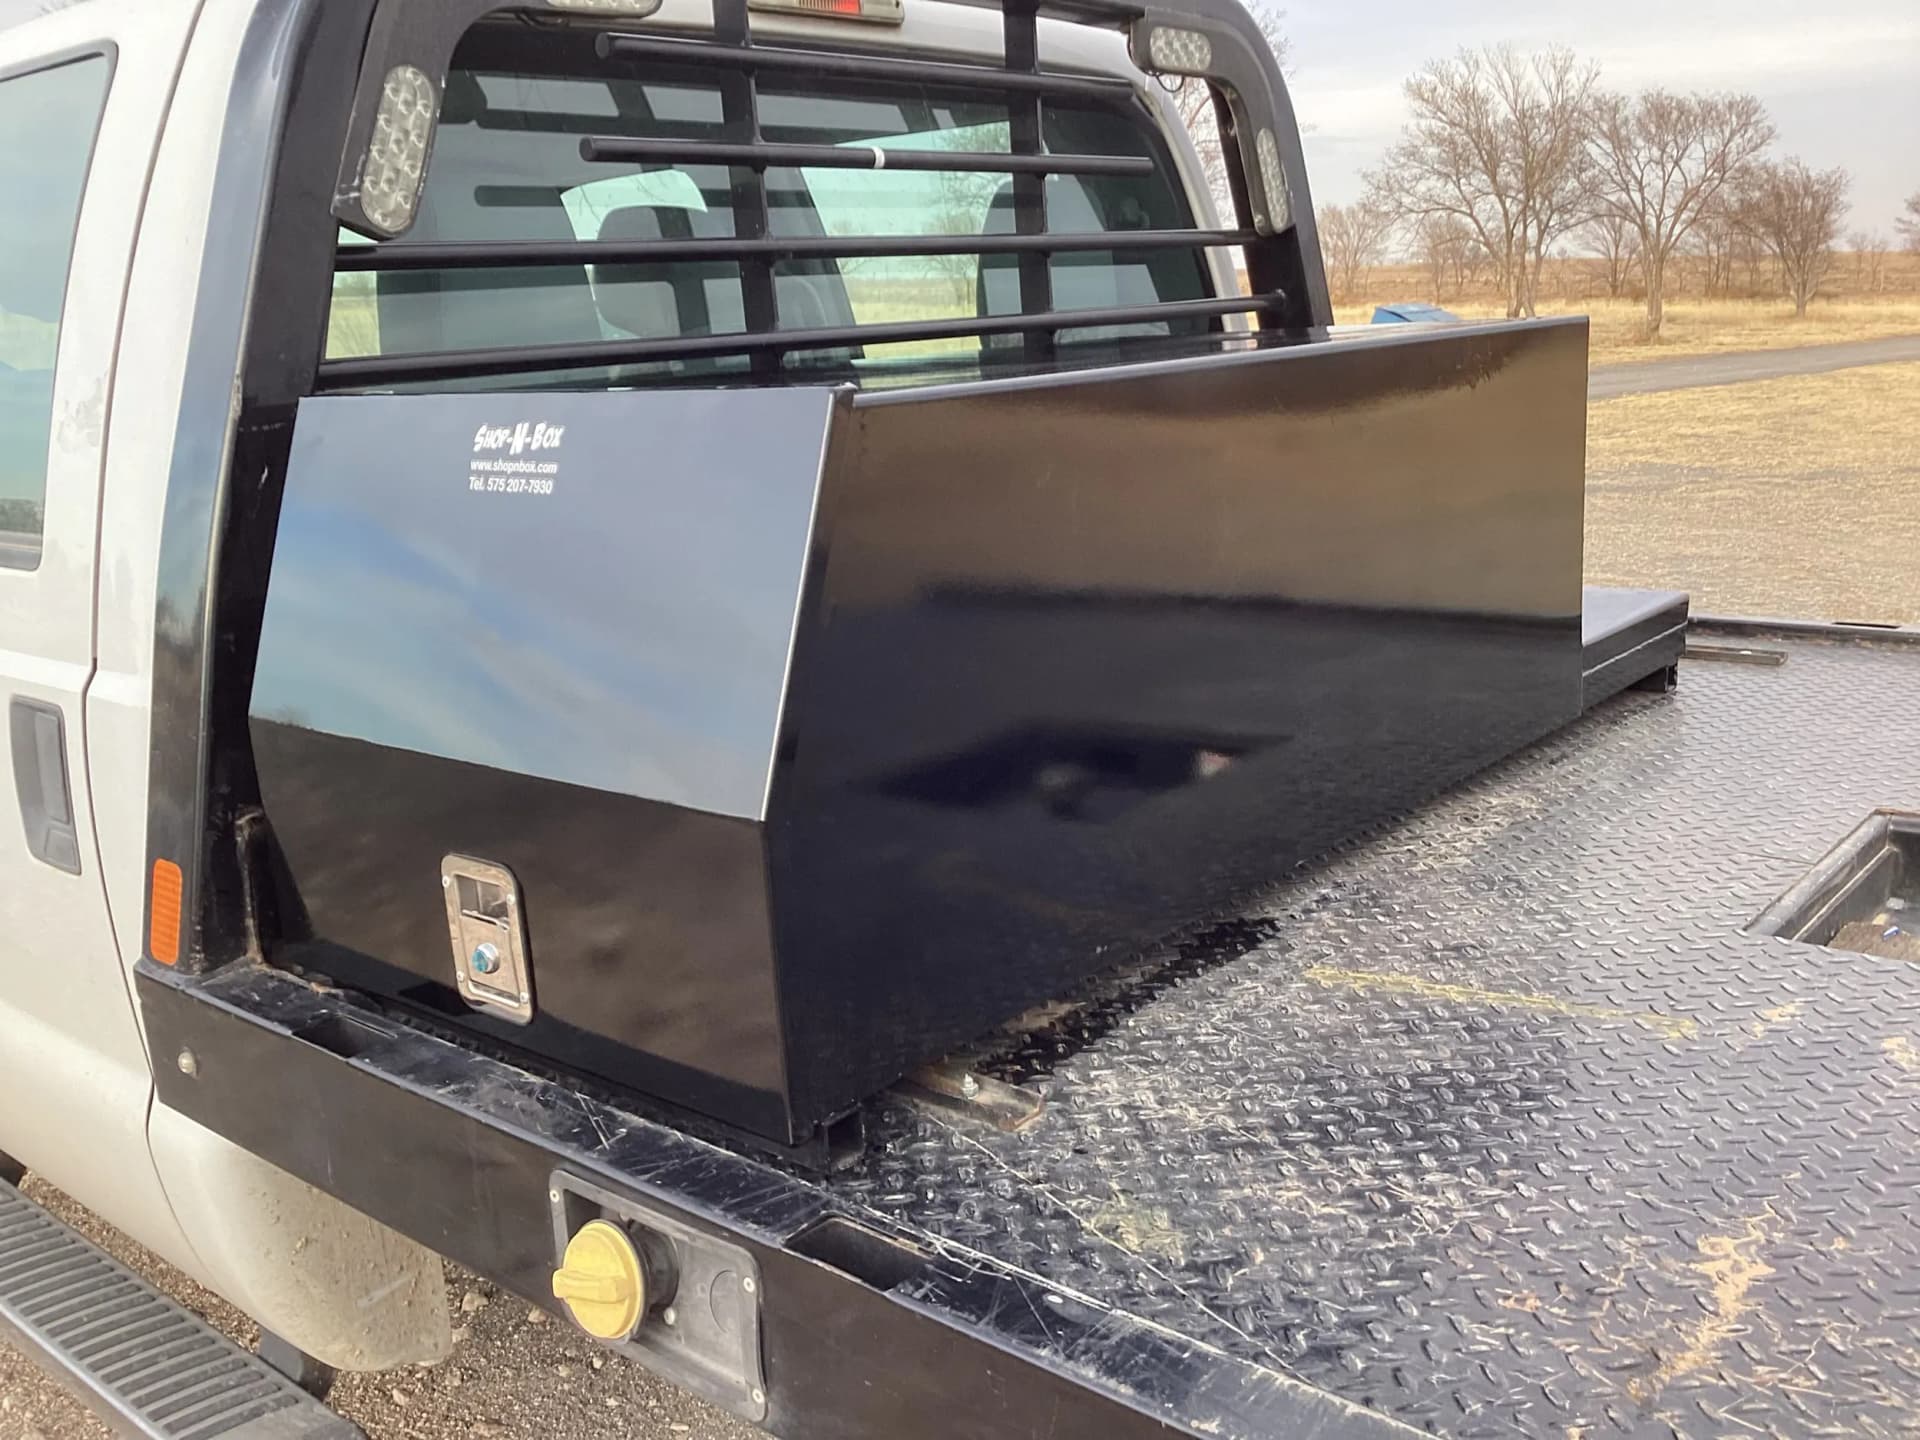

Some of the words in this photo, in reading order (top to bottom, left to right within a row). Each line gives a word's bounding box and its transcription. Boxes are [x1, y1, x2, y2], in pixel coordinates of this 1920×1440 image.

[470, 458, 558, 474] www.shopnbox.com
[487, 477, 505, 492] 575
[506, 478, 554, 495] 207-7930
